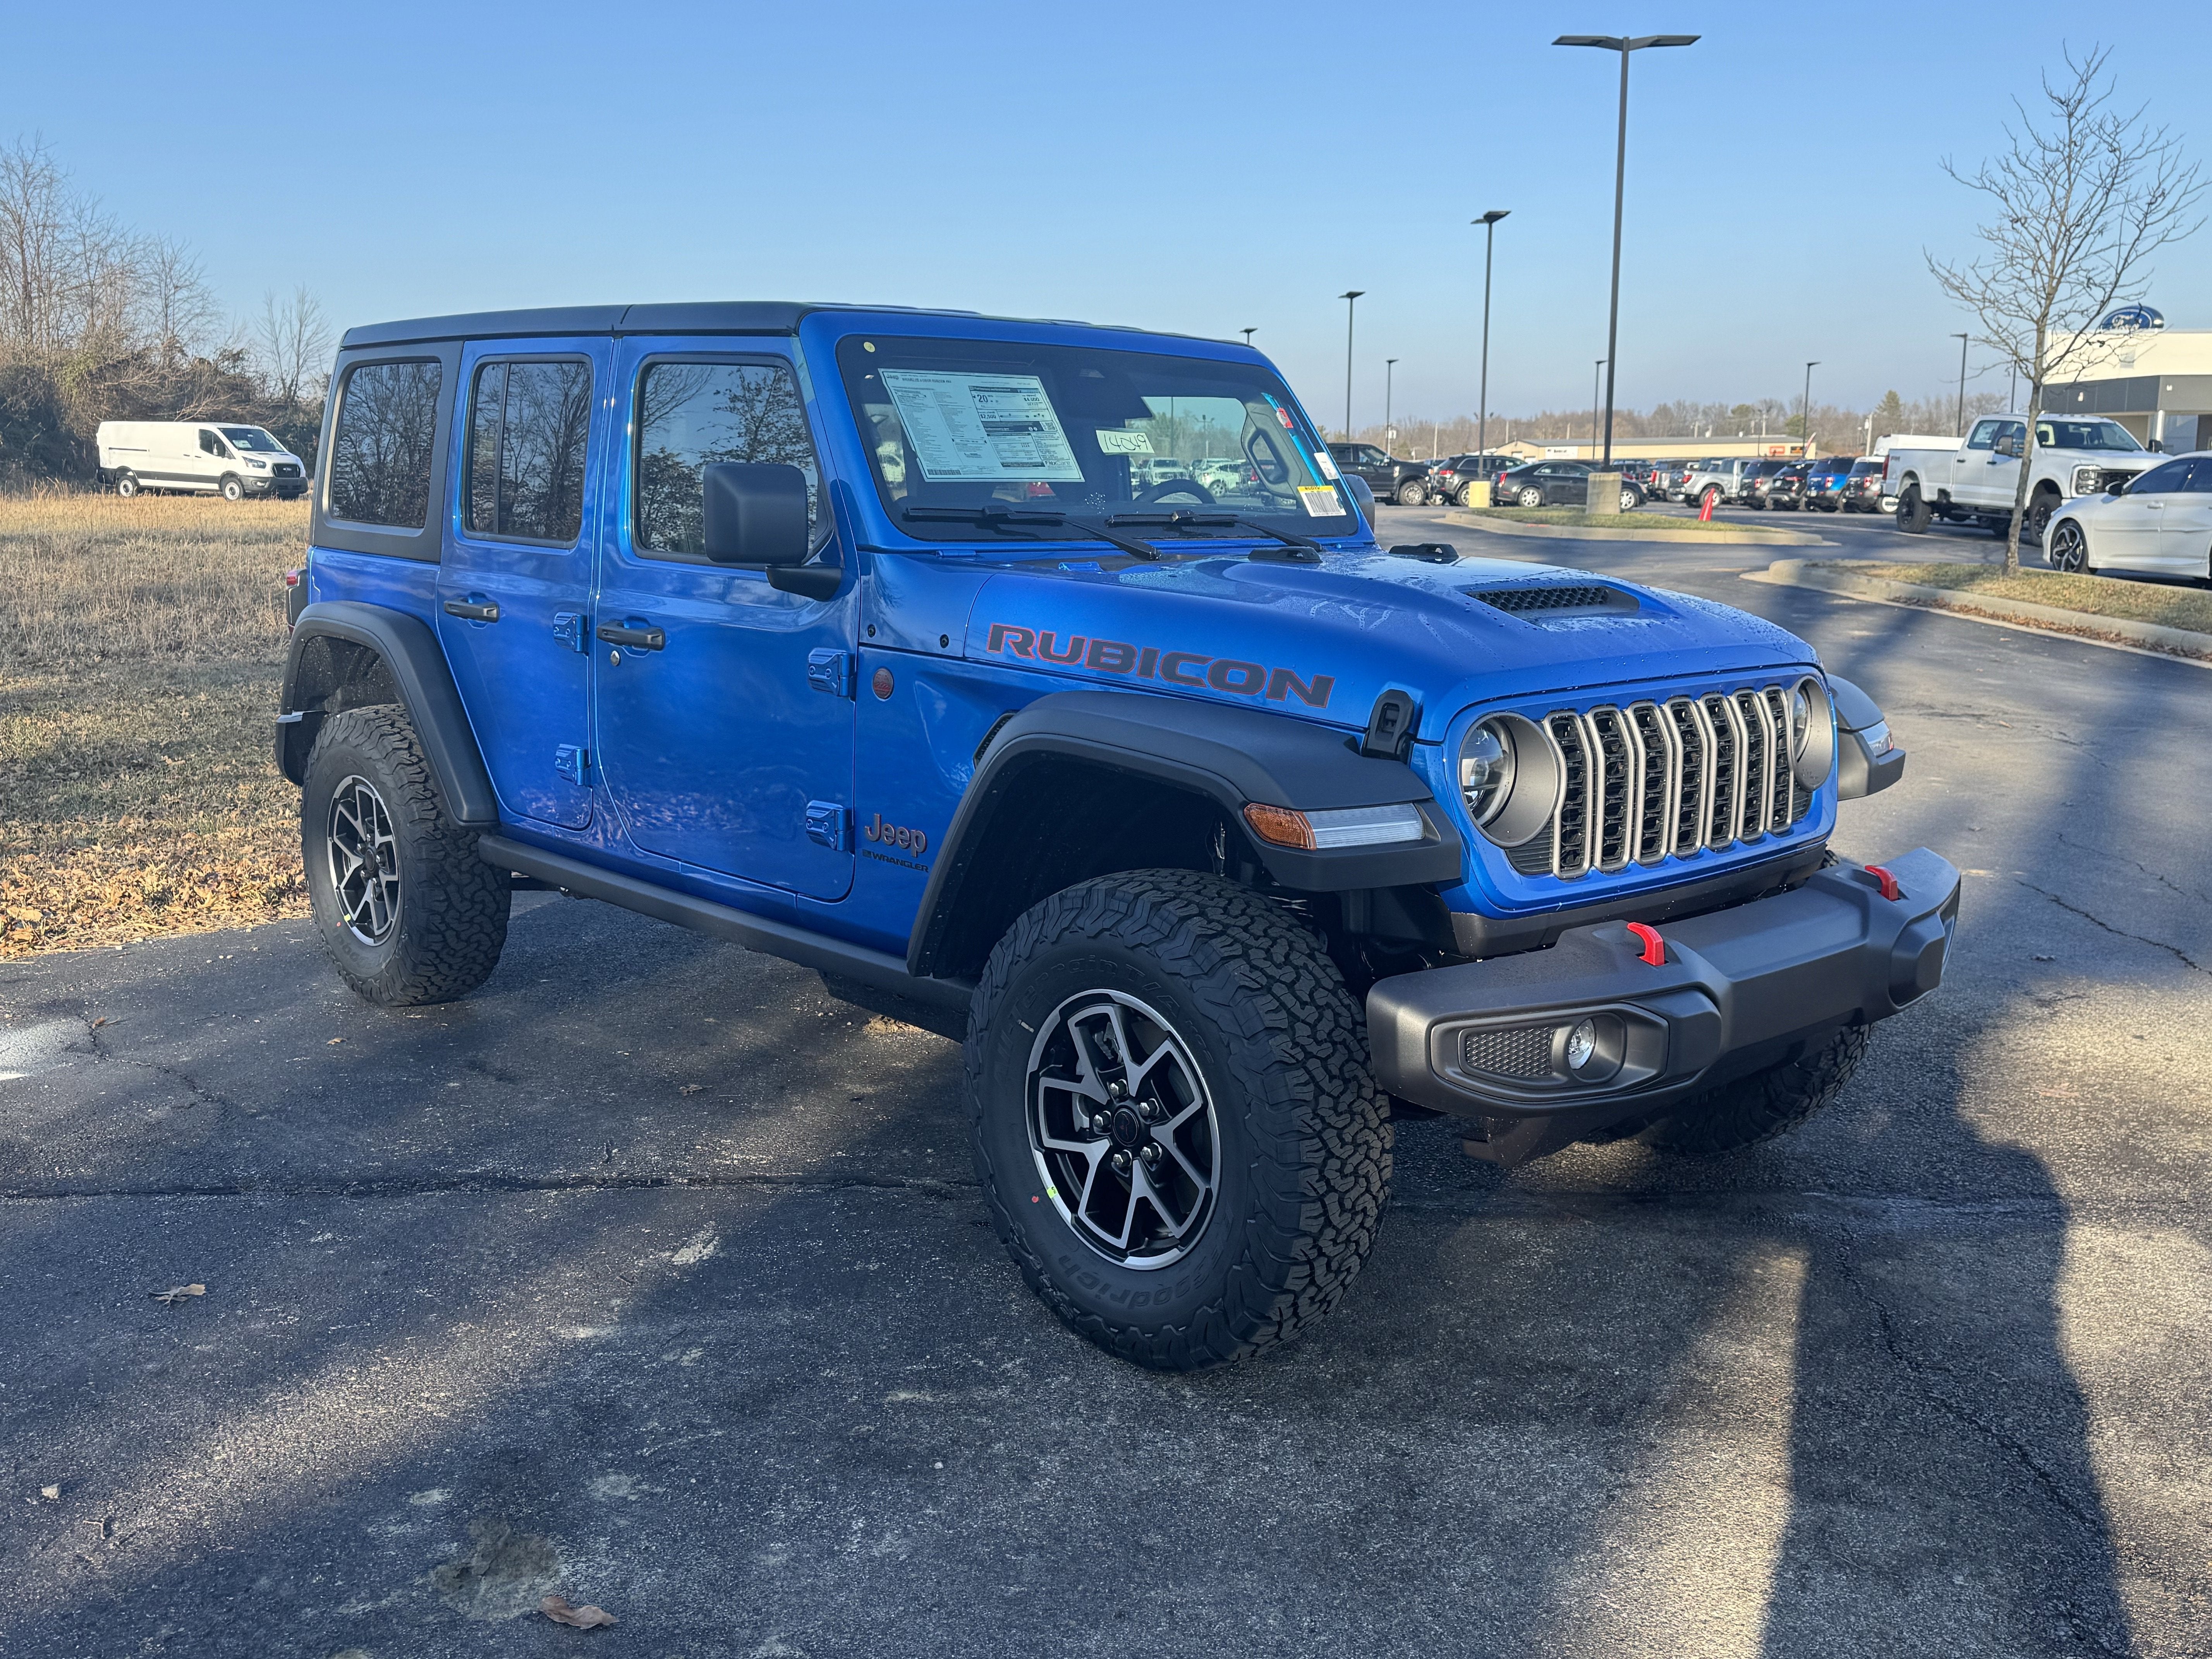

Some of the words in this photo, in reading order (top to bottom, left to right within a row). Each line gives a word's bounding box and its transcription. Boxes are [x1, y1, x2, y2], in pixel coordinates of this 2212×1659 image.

[977, 394, 988, 403] 20
[986, 623, 1335, 709] RUBICON
[864, 813, 927, 858] Jeep
[871, 851, 929, 873] WRANGLER
